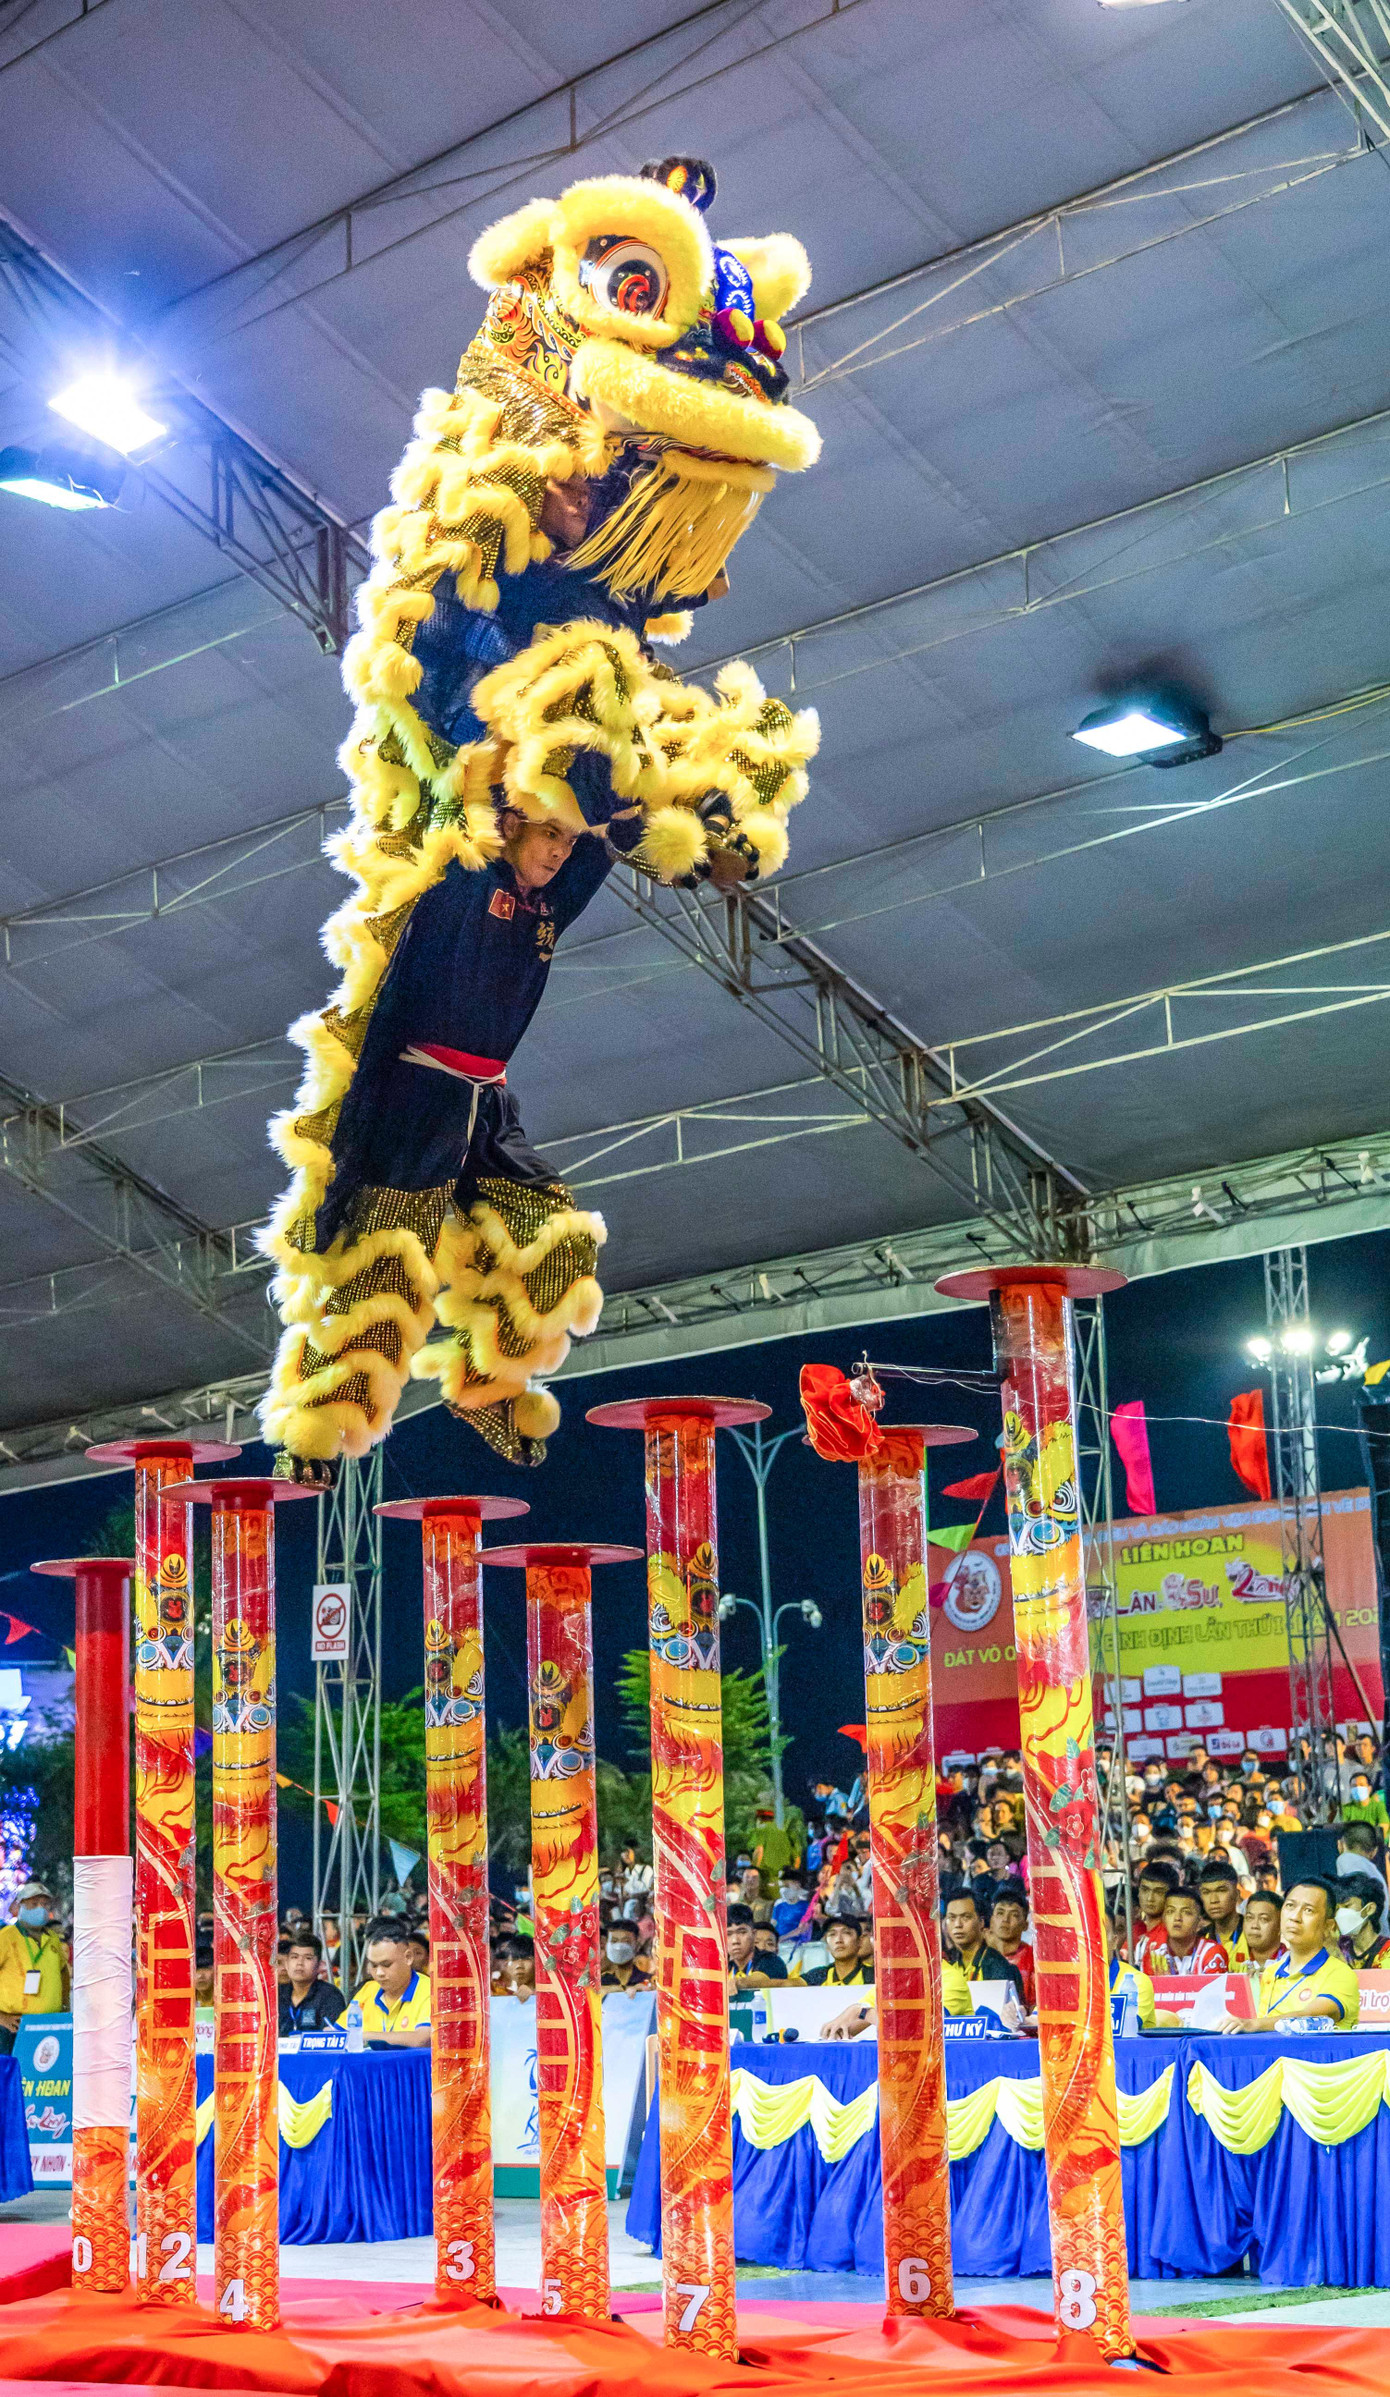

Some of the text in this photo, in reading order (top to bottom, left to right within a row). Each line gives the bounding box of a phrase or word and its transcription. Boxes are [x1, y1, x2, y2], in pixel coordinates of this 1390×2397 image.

[1121, 1534, 1244, 1565] LIÊN HOAN
[303, 2036, 326, 2050] TRỌNG
[326, 2034, 339, 2048] TÀI
[339, 2036, 346, 2048] 5
[965, 2019, 983, 2037] KÝ
[35, 2079, 71, 2097] HOAN
[446, 2239, 476, 2281] 3
[219, 2278, 249, 2322] 4
[543, 2278, 564, 2316] 5
[898, 2257, 931, 2304] 6
[1058, 2269, 1098, 2331] 8
[676, 2282, 711, 2333] 7
